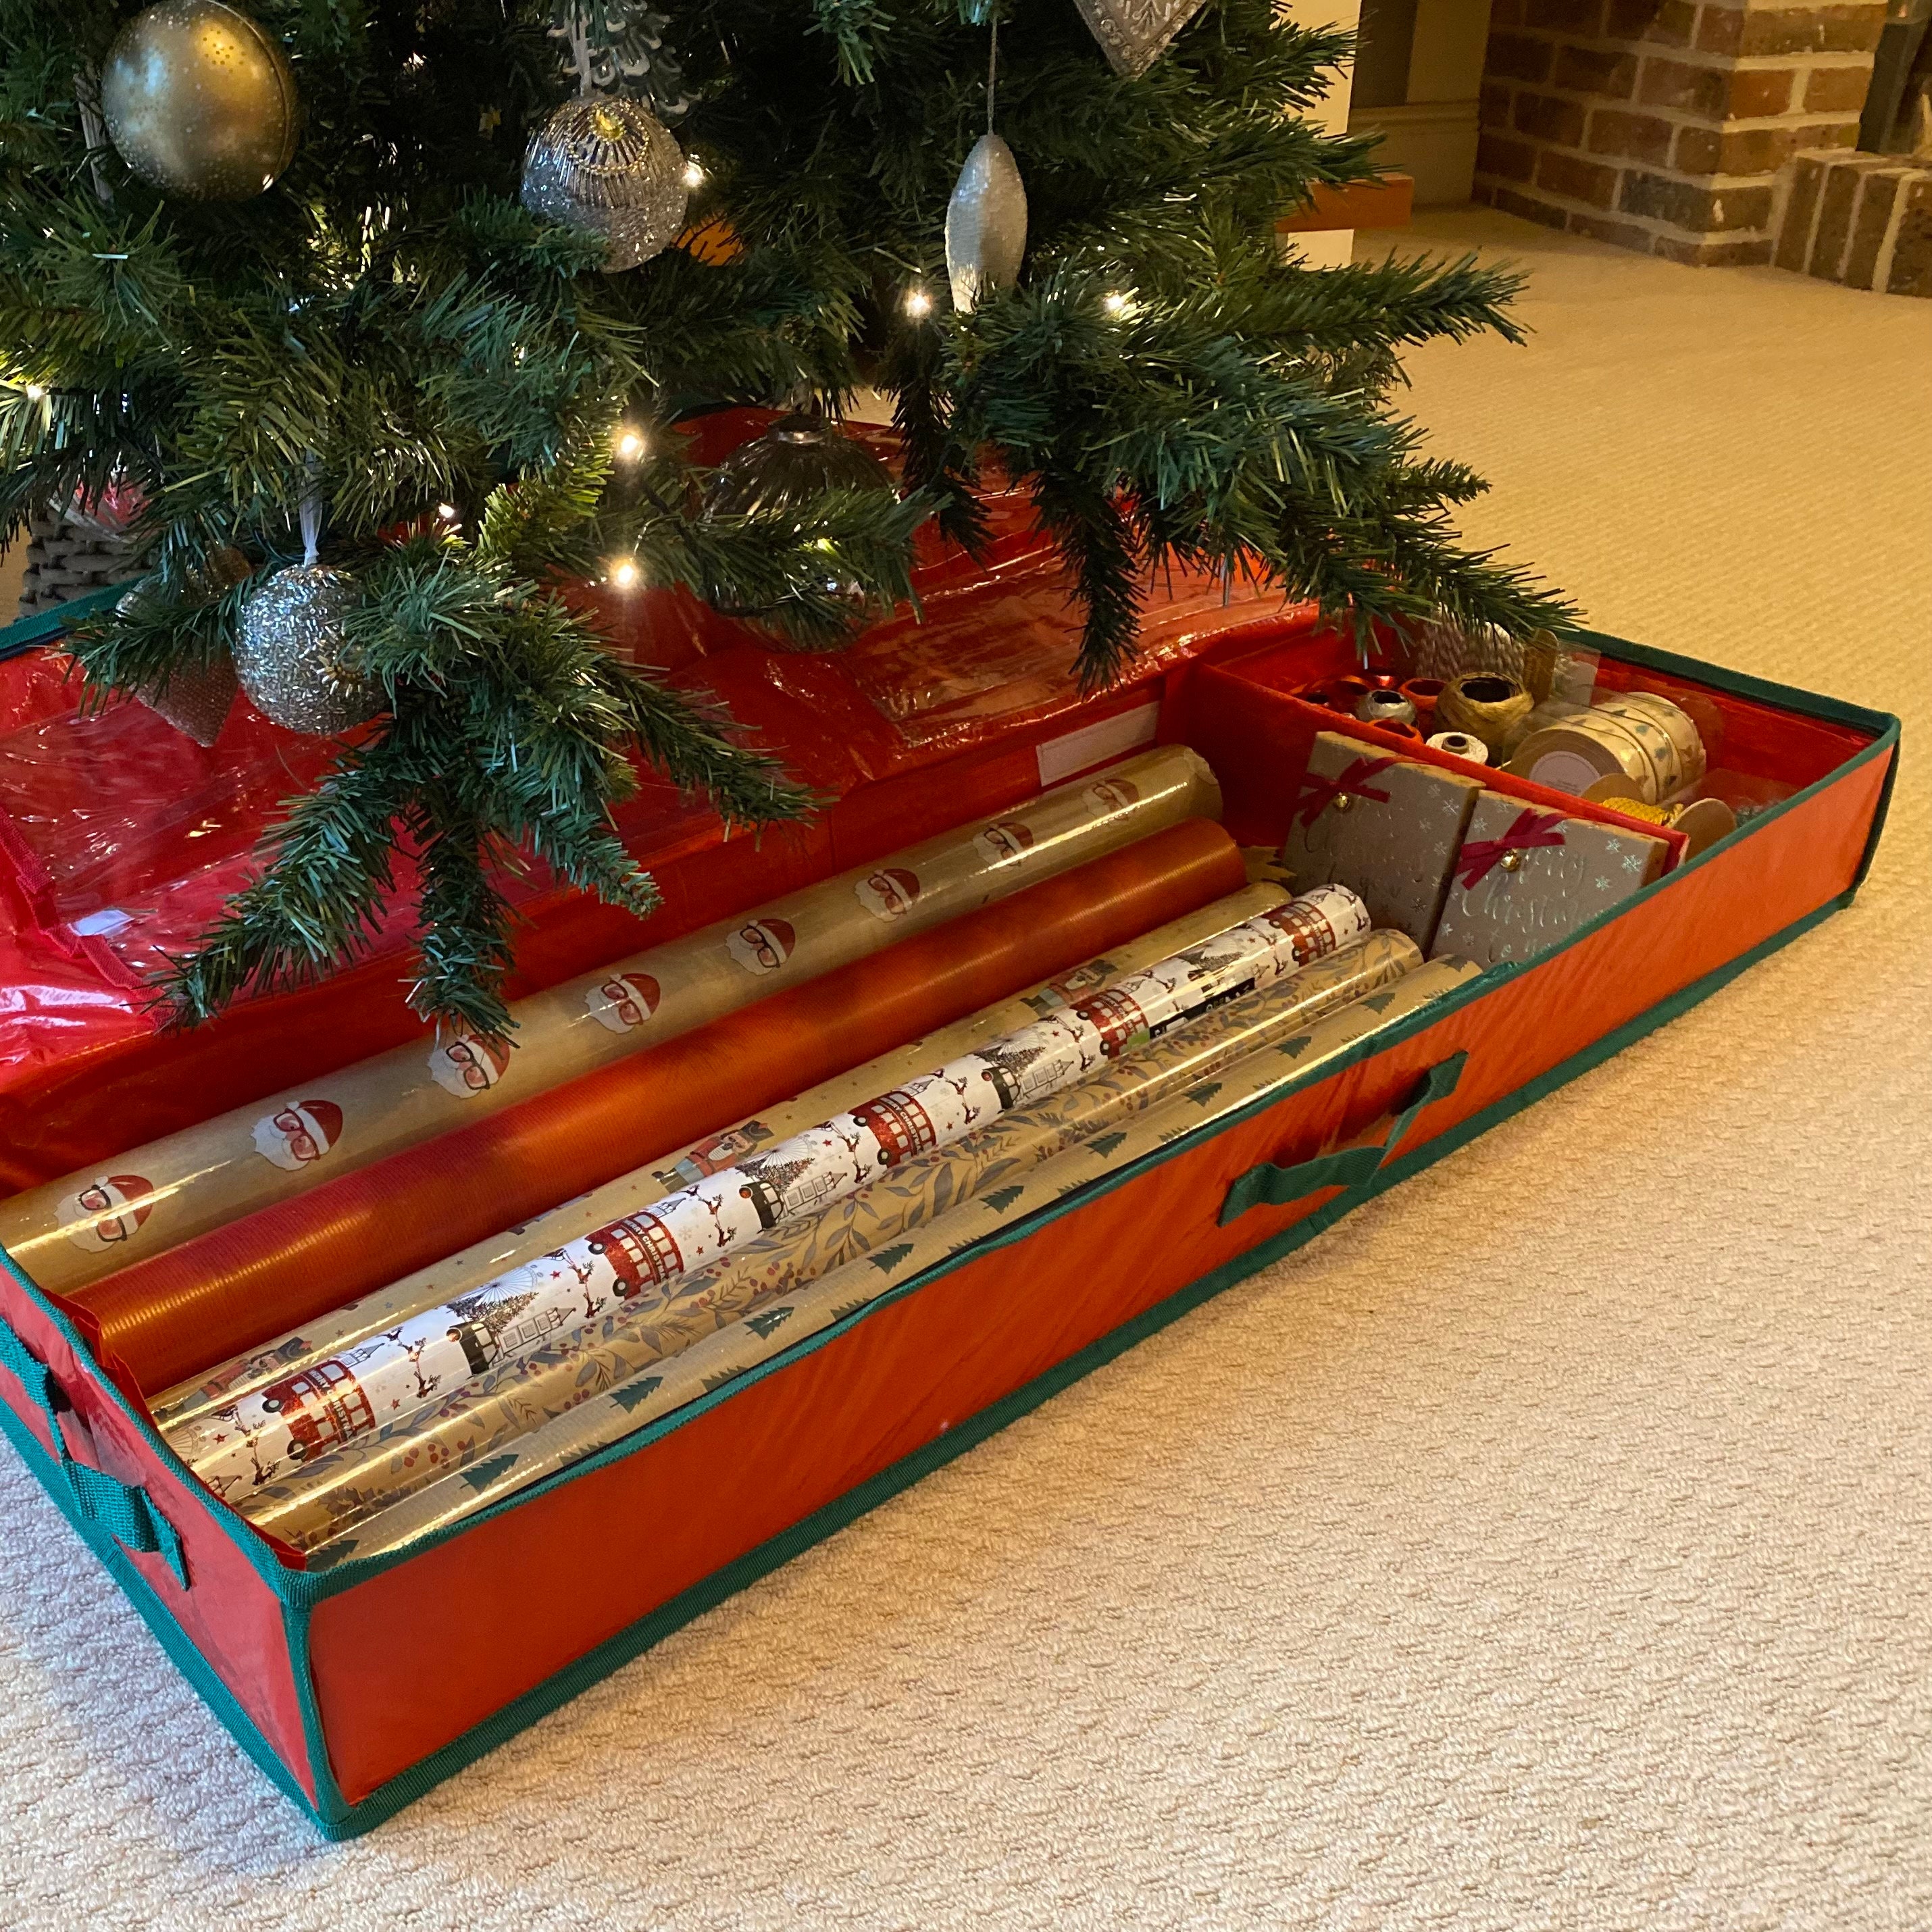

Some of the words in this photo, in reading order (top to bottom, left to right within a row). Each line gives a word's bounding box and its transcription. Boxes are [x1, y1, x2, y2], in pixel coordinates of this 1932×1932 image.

[900, 1111, 922, 1152] CHRISTMA
[642, 1236, 666, 1279] CHRISTMA
[327, 1390, 353, 1439] CHRISTMA
